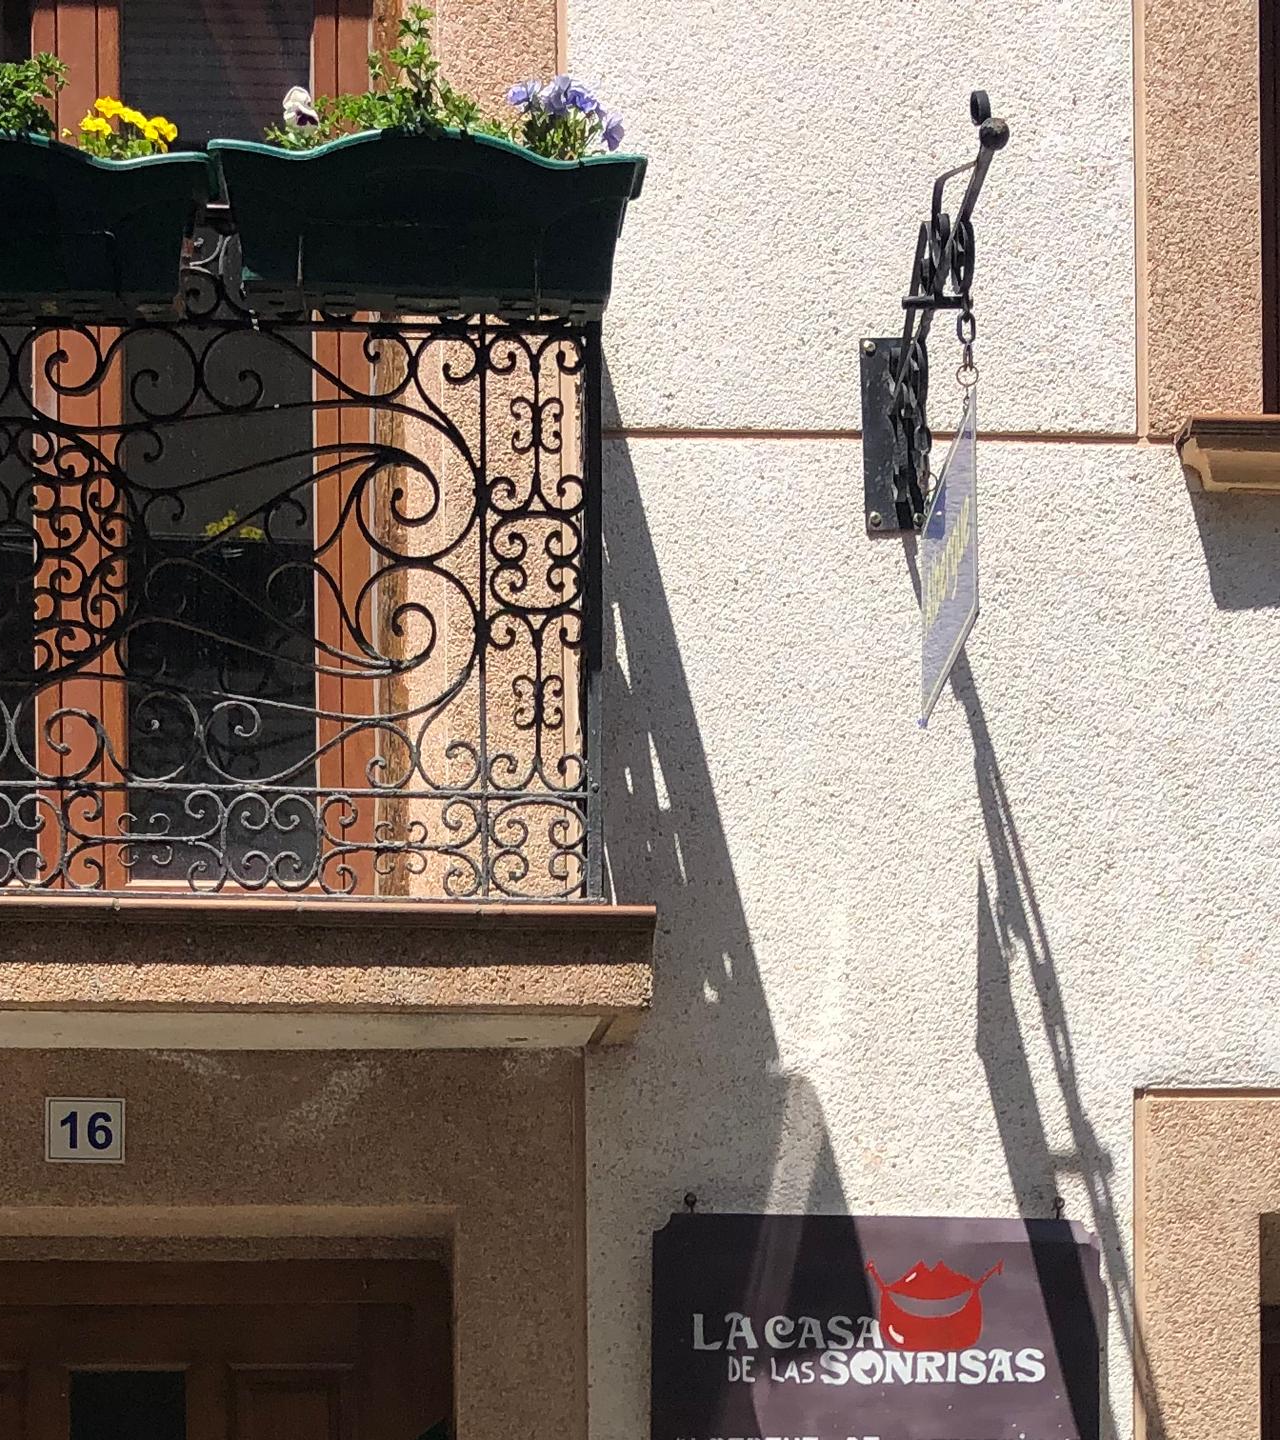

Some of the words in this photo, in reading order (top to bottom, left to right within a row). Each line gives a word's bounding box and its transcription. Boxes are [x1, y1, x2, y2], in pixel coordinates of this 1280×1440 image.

[60, 1111, 113, 1150] 16
[692, 1312, 758, 1351] LA
[765, 1314, 884, 1350] CASA
[728, 1355, 756, 1384] DE
[770, 1358, 815, 1384] LAS
[820, 1348, 1046, 1386] SONRISAS
